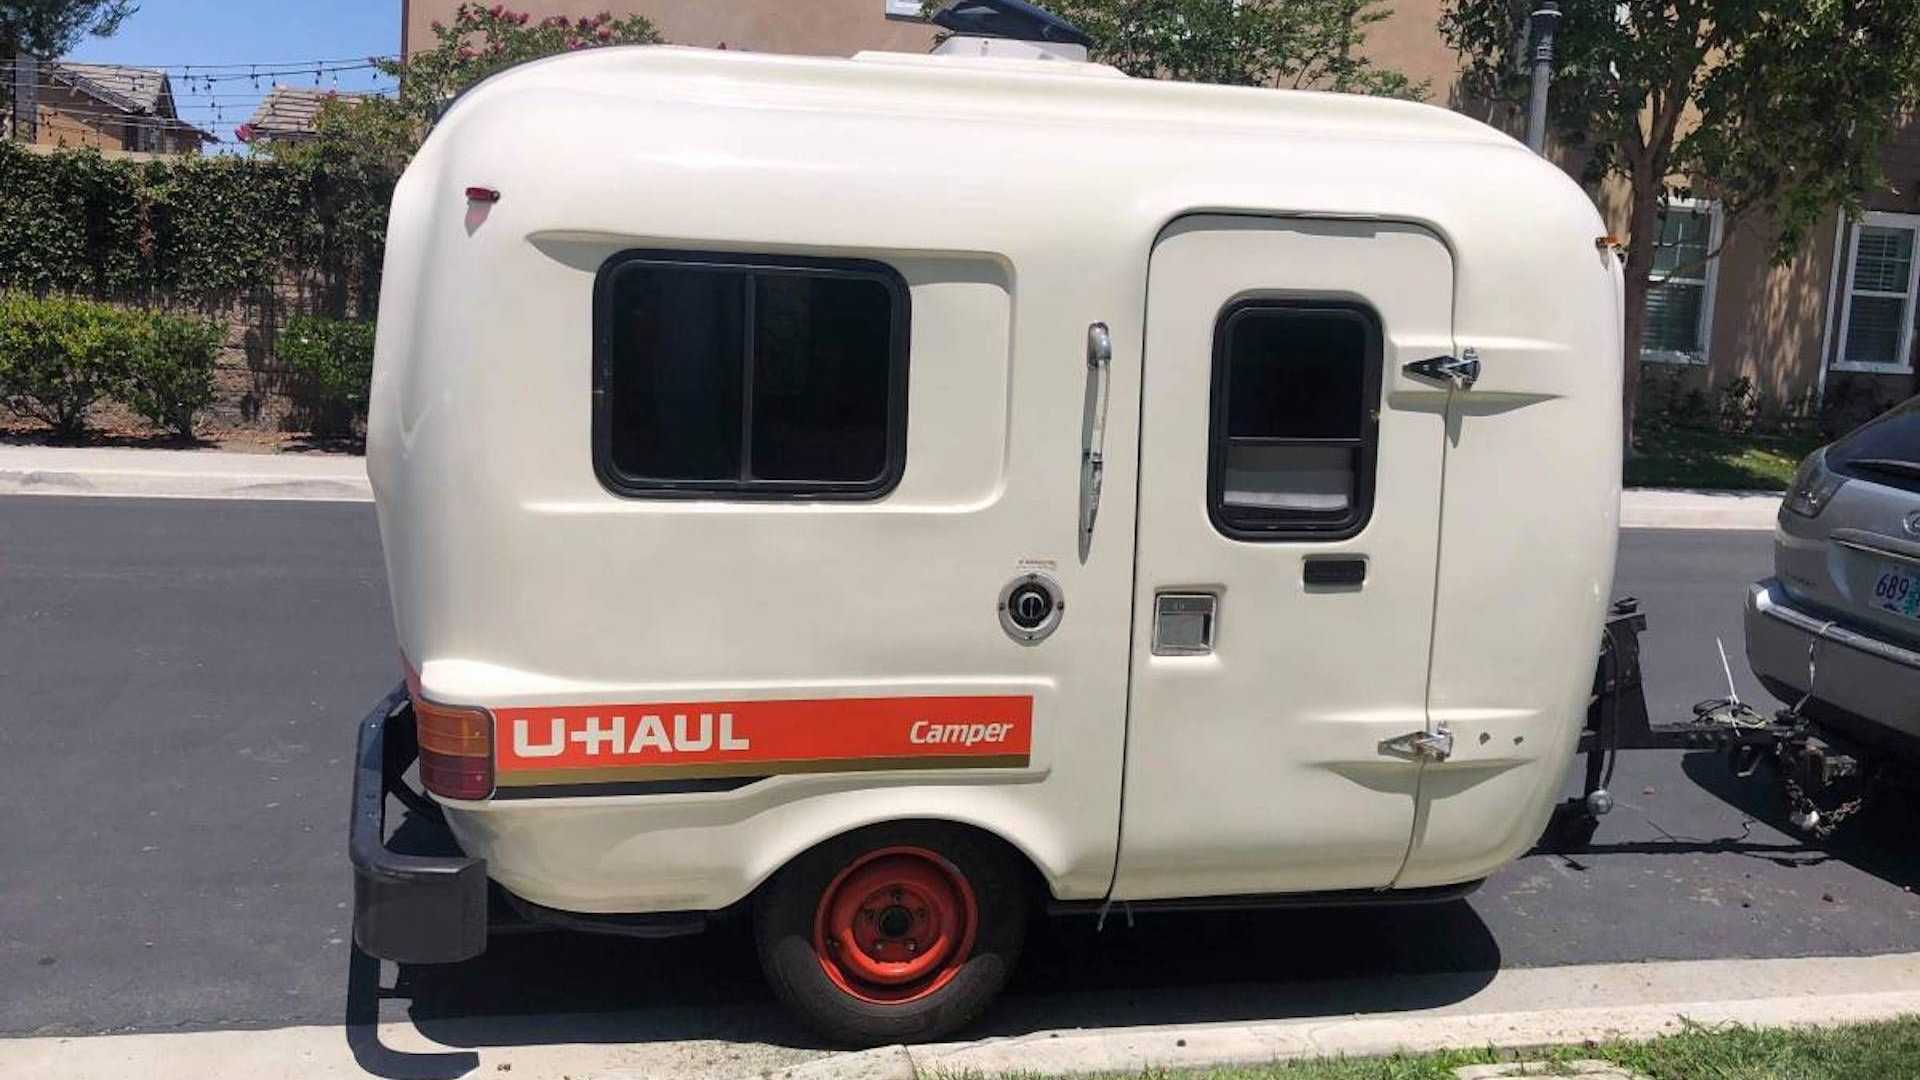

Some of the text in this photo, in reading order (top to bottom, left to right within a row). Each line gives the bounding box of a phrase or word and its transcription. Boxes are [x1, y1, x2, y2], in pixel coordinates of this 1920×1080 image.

[1875, 573, 1910, 600] 689
[513, 713, 750, 757] U-HAUL
[909, 719, 1014, 746] Camper
